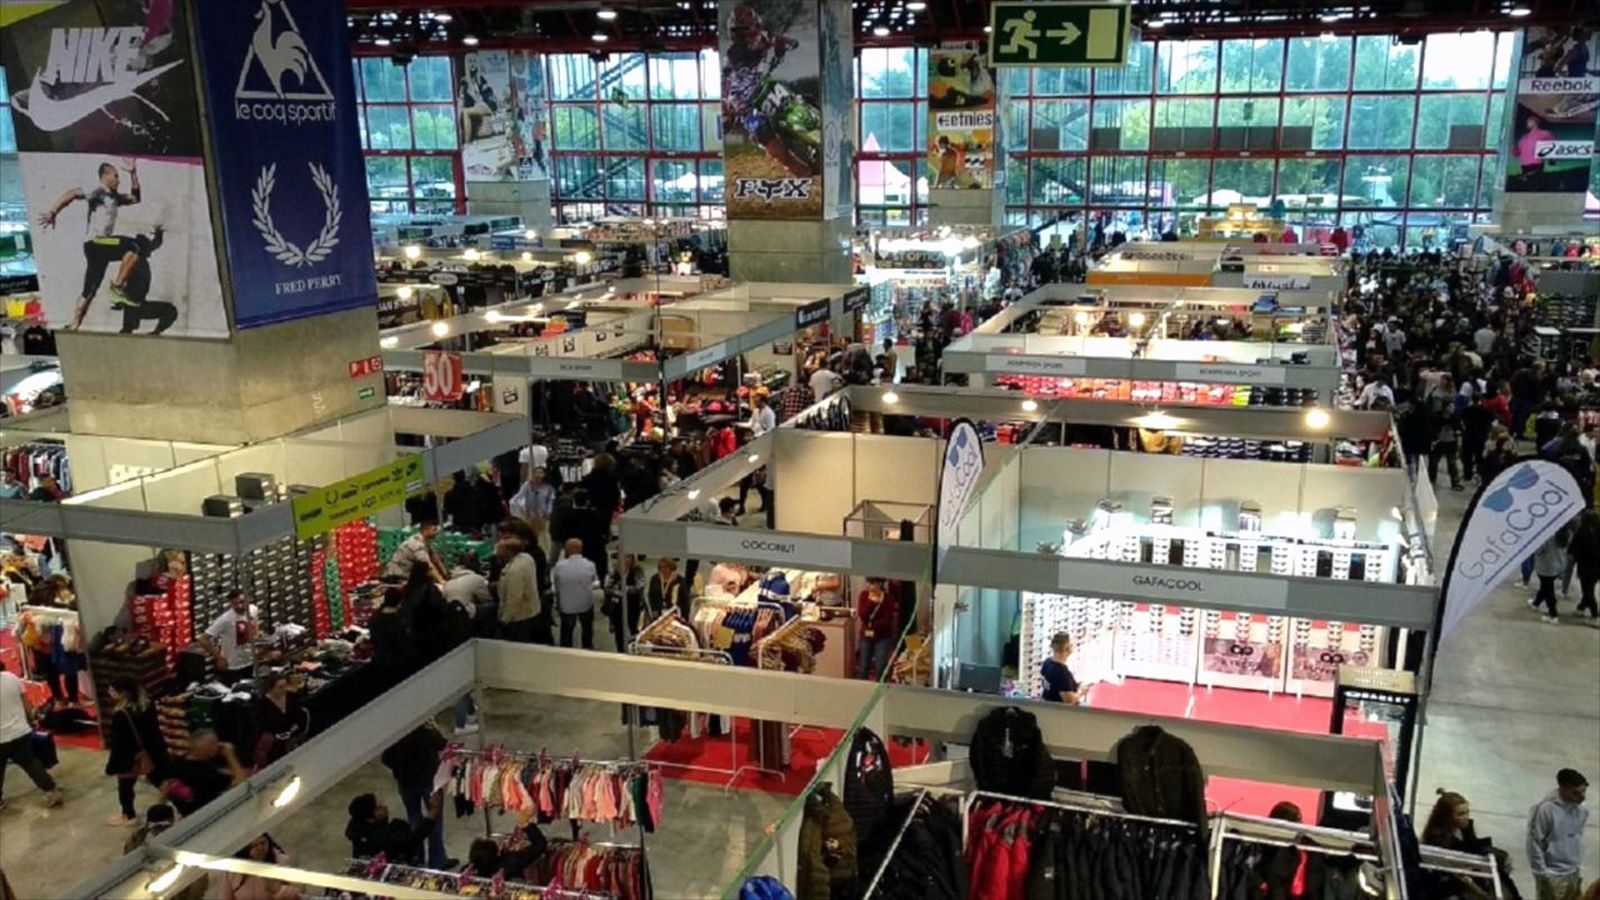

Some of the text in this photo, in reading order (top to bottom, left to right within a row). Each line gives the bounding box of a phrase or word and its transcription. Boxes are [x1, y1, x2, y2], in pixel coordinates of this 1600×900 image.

[43, 26, 146, 84] NIKE
[1531, 80, 1593, 92] Reebok
[235, 99, 336, 126] le coq sportif
[950, 112, 993, 127] etnies
[276, 274, 341, 296] FRED PERRY
[1459, 479, 1570, 580] GafaCool
[741, 539, 795, 553] COCONUT
[1132, 575, 1205, 591] GAFACOOL
